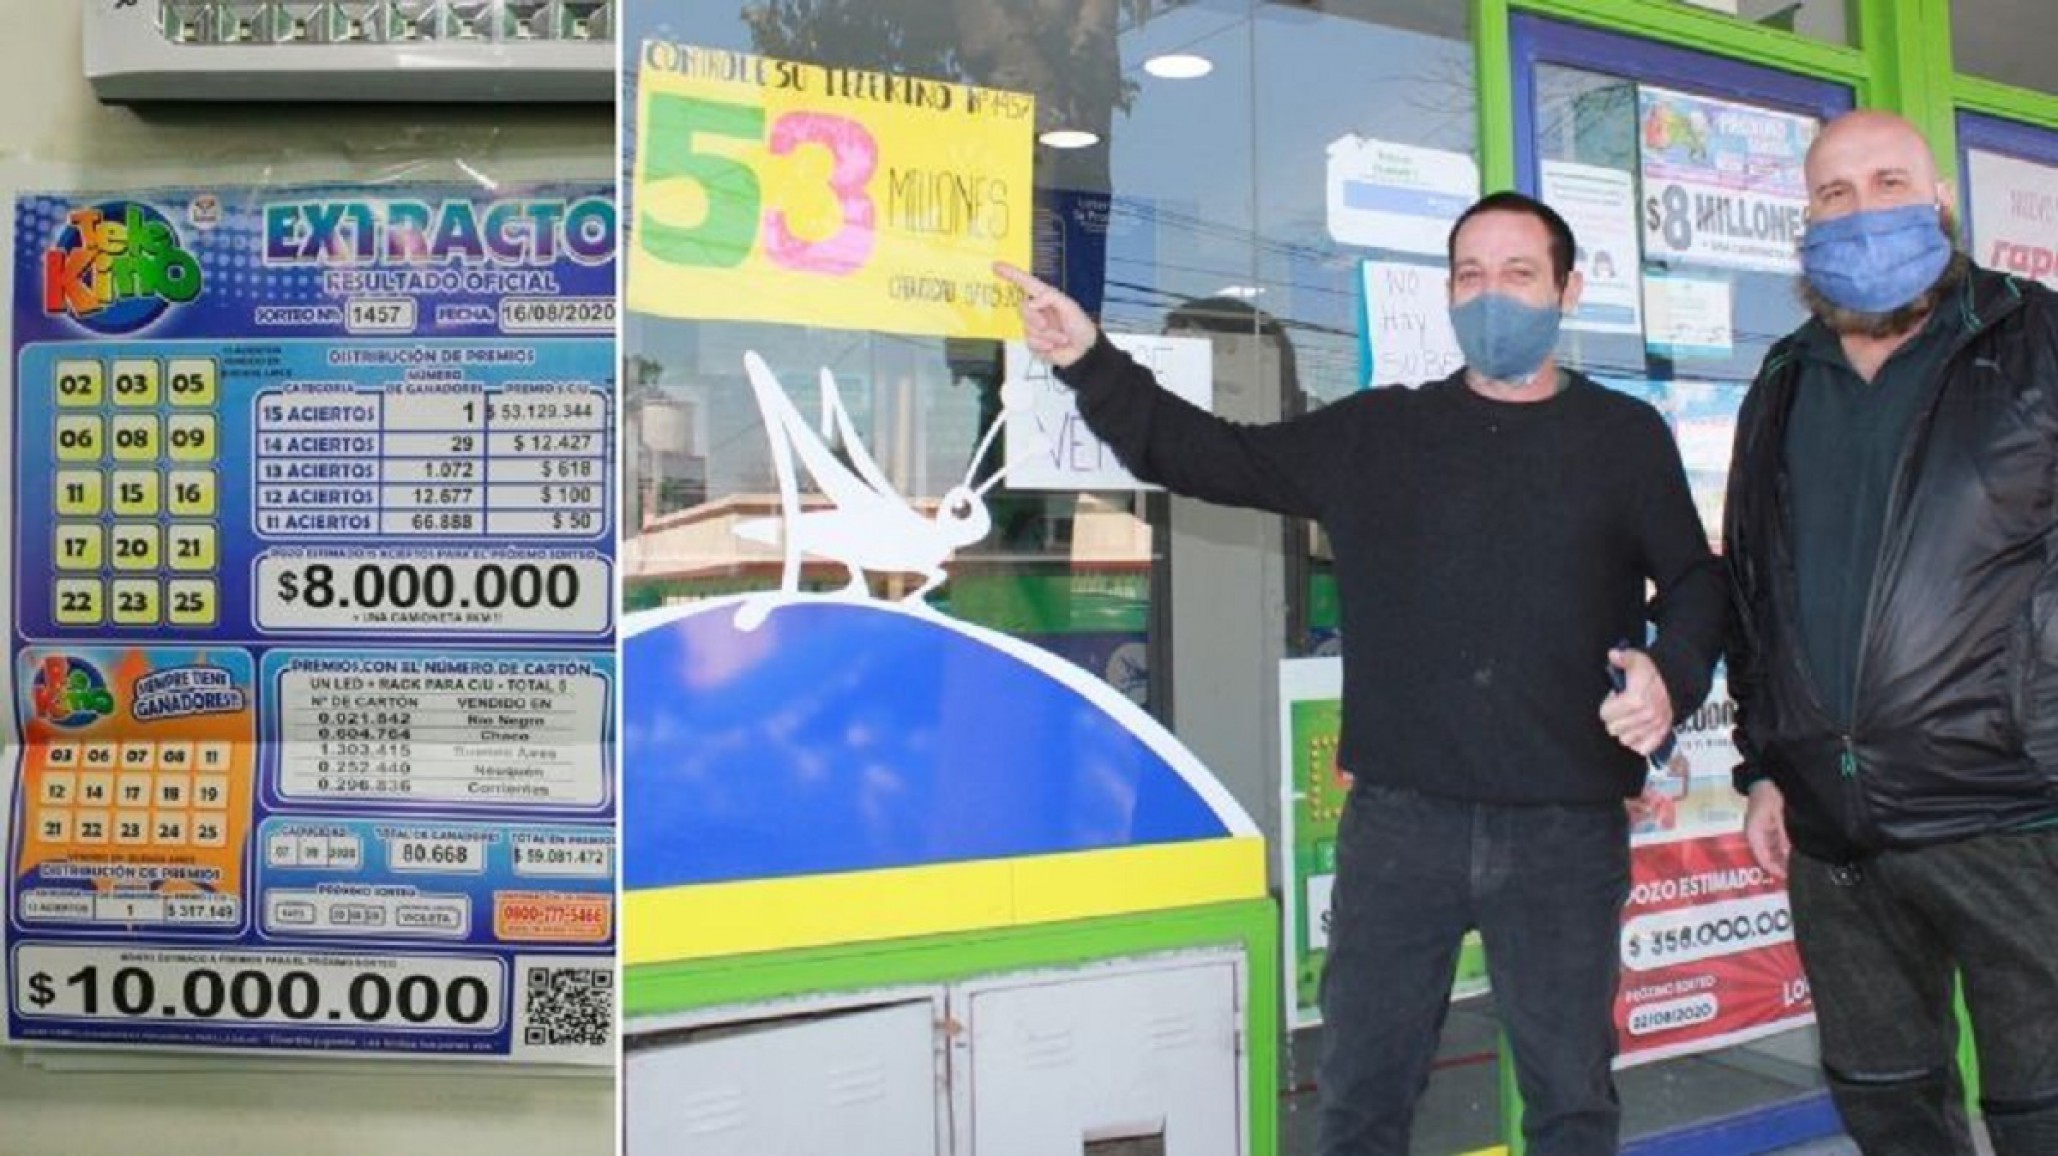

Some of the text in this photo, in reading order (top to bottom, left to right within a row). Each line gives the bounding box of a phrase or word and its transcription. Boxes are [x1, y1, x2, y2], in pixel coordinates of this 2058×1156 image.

[641, 91, 878, 276] 53
[889, 167, 1010, 240] MILLONES
[263, 199, 616, 265] EXTRACTO
[1989, 241, 2058, 280] rap
[326, 271, 557, 292] RESULTADO OFICIAL
[257, 307, 315, 323] SORTEO
[353, 306, 401, 323] 1457
[502, 304, 616, 322] 16/08/2020
[328, 346, 535, 364] DISTRIBUCIÓN DE PREMIOS
[60, 374, 204, 394] 02 03 05
[264, 402, 593, 424] 15 ACIERTOS 1 53.129.344
[60, 429, 204, 448] 06 08 09
[264, 435, 592, 452] 14 ACIERTOS 29 $ 12.427
[264, 461, 592, 478] 13 ACIERTOS 1.072 $ 618
[66, 484, 201, 503] 11 15 16
[264, 487, 592, 504] 12 ACIERTOS 12.677 $ 100
[265, 513, 592, 530] 11 ACIERTOS 66.888 $ 50
[64, 538, 200, 557] 17 20 21
[61, 592, 204, 612] 22 23 25
[363, 661, 397, 673] CON
[401, 661, 421, 674] EL
[424, 659, 493, 674] NÚMERO
[499, 662, 520, 675] DE
[524, 660, 591, 675] CARTÓN
[311, 678, 330, 690] UN
[334, 678, 364, 690] LED
[379, 678, 421, 690] RACK
[424, 678, 465, 691] PARA
[507, 678, 553, 692] TOTAL
[332, 695, 418, 708] DE CARTÓN
[457, 697, 552, 709] VENDIDO EN
[498, 714, 545, 728] Negro
[480, 730, 529, 742] Chaco
[51, 749, 218, 763] 03 06 07 08 11
[49, 785, 218, 800] 12 14 17 18 19
[466, 781, 550, 797] Corrientes
[44, 822, 217, 839] 21 22 23 24 25
[403, 843, 468, 864] 80.668
[126, 904, 134, 916] 1
[1633, 1002, 1713, 1030] 22/08/2020
